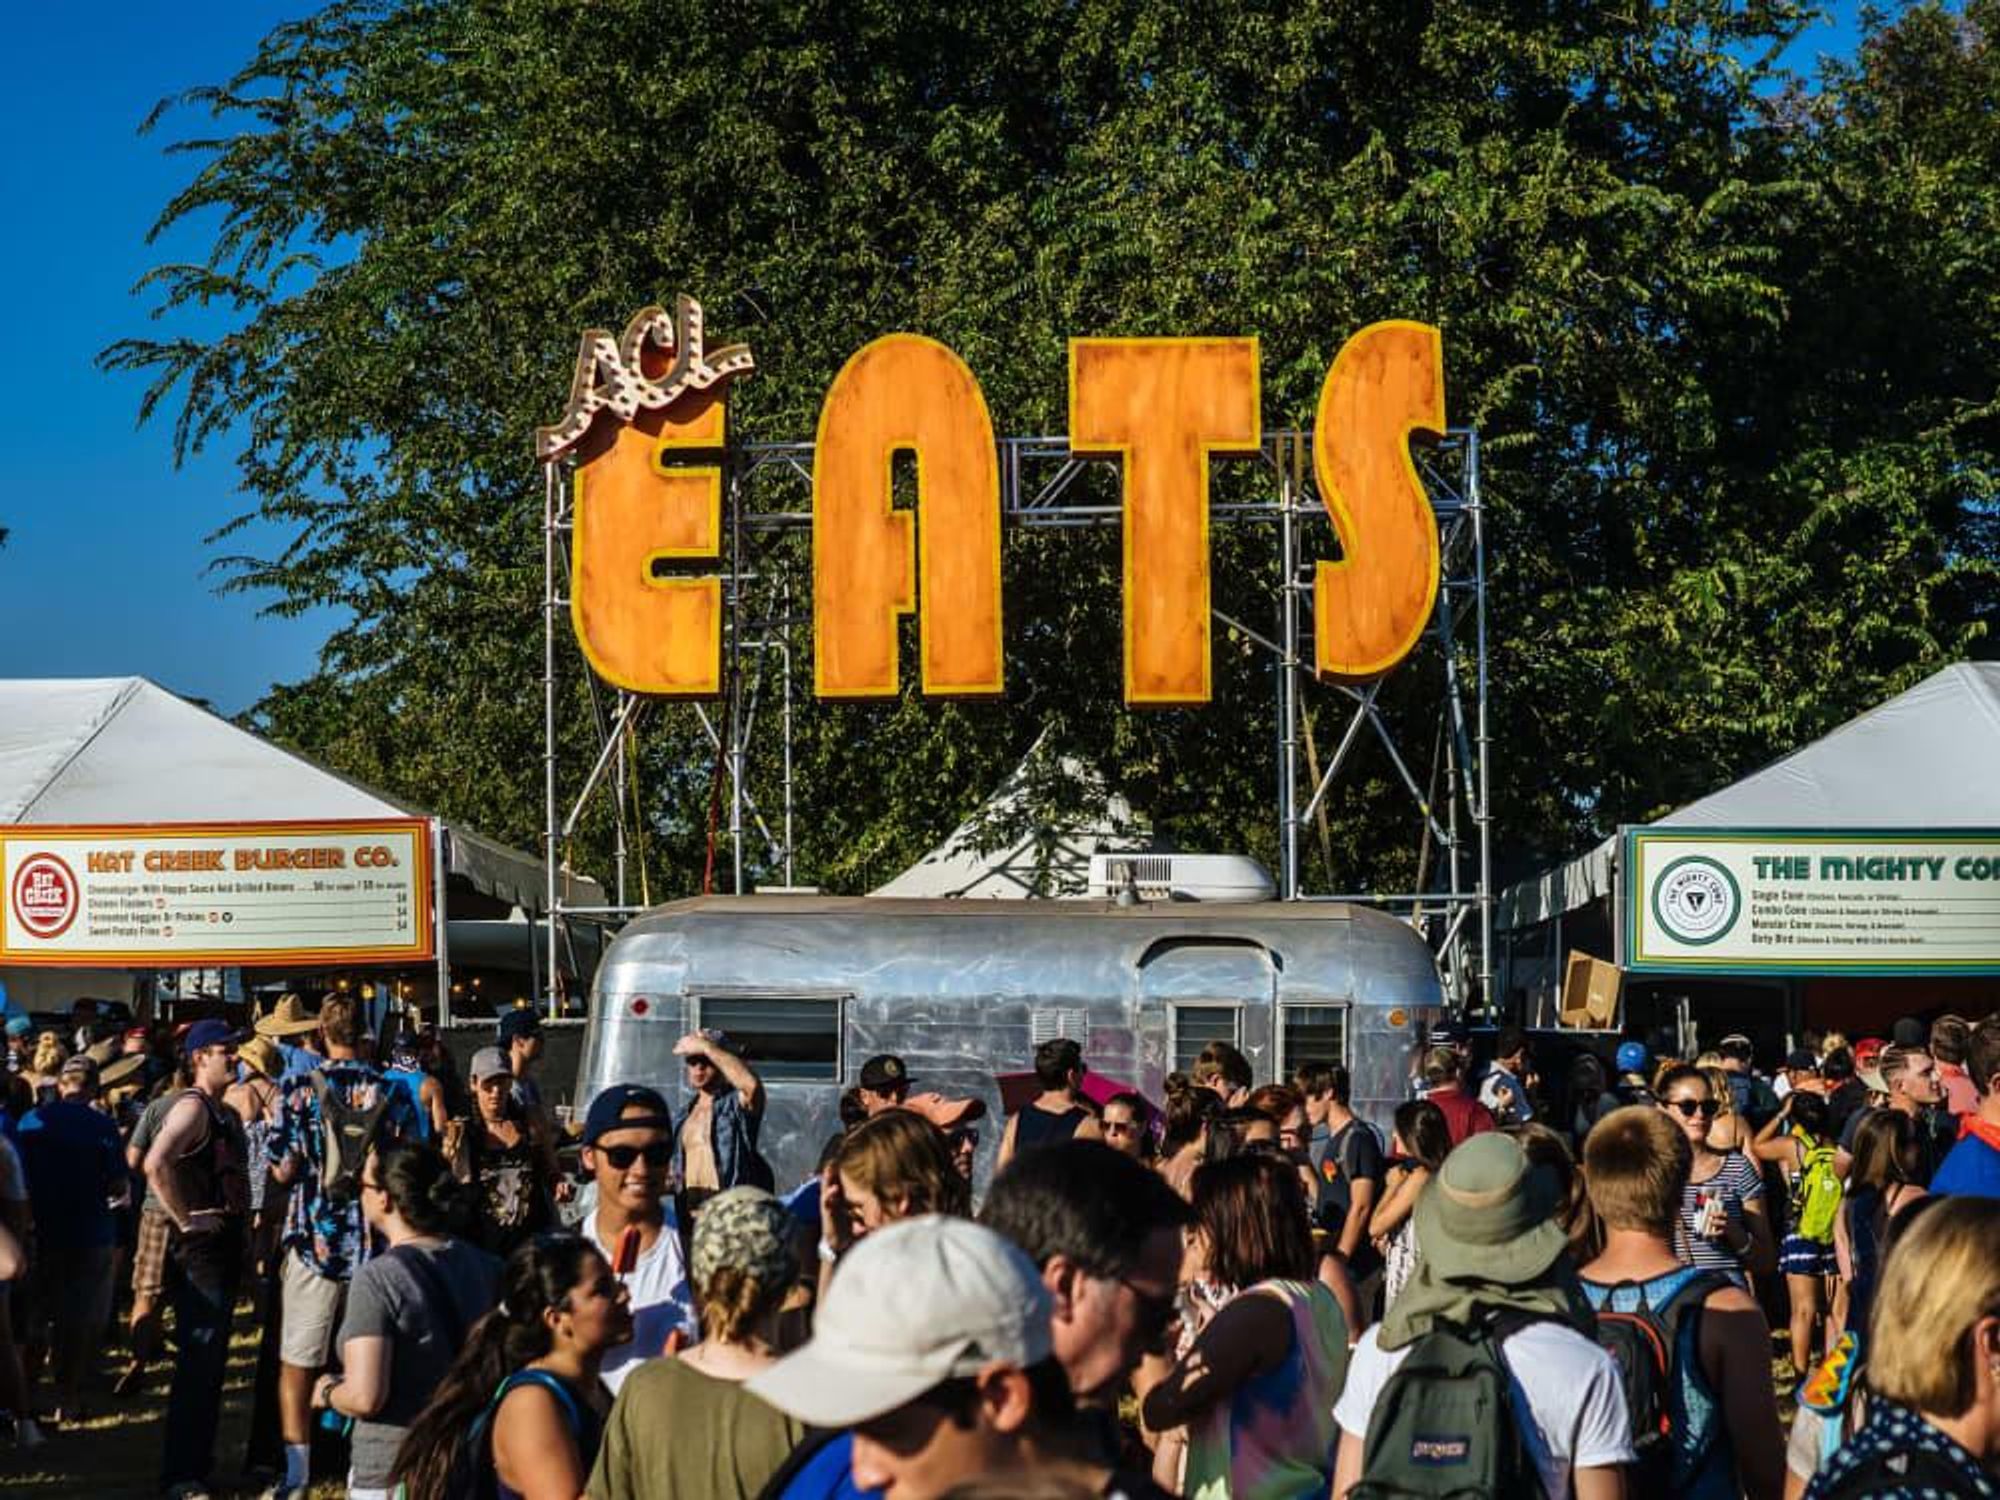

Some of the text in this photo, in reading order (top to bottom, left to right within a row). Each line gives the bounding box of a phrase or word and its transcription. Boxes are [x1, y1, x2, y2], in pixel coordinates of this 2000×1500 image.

[537, 293, 755, 460] ACL
[571, 319, 1447, 703] EATS
[87, 846, 400, 873] HAT CREEK BURGER CO.
[1752, 856, 1811, 881] THE
[1820, 856, 1946, 881] MIGHTY
[1785, 904, 1807, 915] Cone
[1790, 918, 1812, 929] Cone
